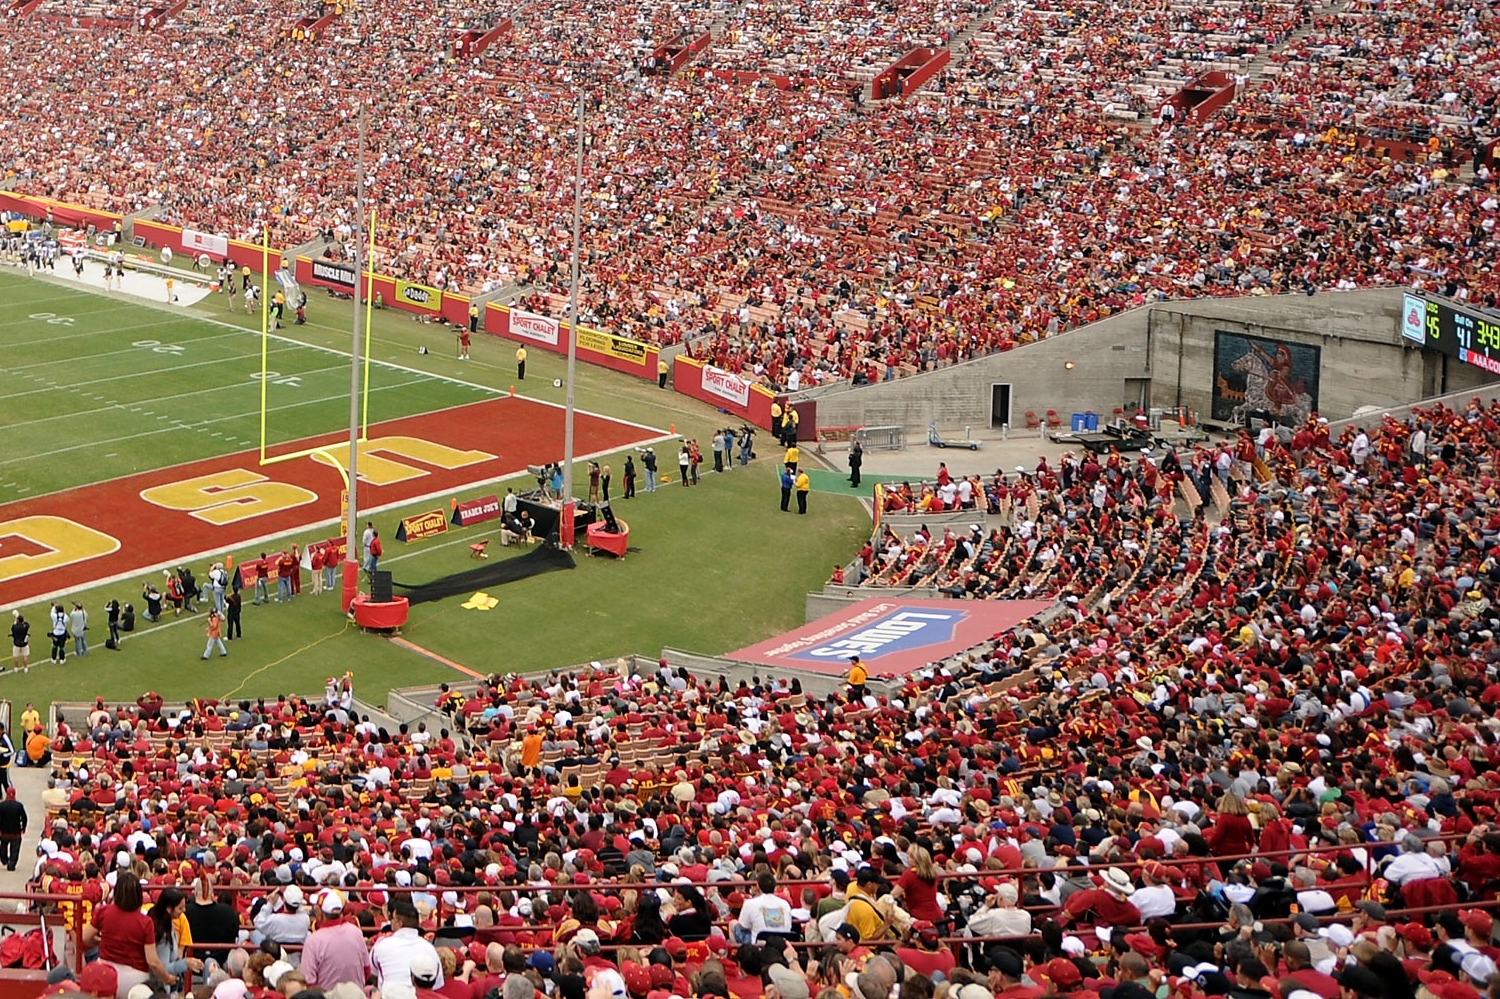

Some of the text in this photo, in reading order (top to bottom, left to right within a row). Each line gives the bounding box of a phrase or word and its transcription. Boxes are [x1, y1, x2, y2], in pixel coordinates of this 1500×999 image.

[314, 263, 340, 280] MUSCLE
[1426, 301, 1438, 314] USC
[512, 317, 555, 336] SPORT CHALET
[1427, 315, 1440, 339] 45
[1457, 327, 1471, 348] 41
[706, 371, 746, 395] SPORT CHALET
[460, 502, 499, 519] TRADER JOE'S
[405, 517, 444, 535] SPORT CHALET
